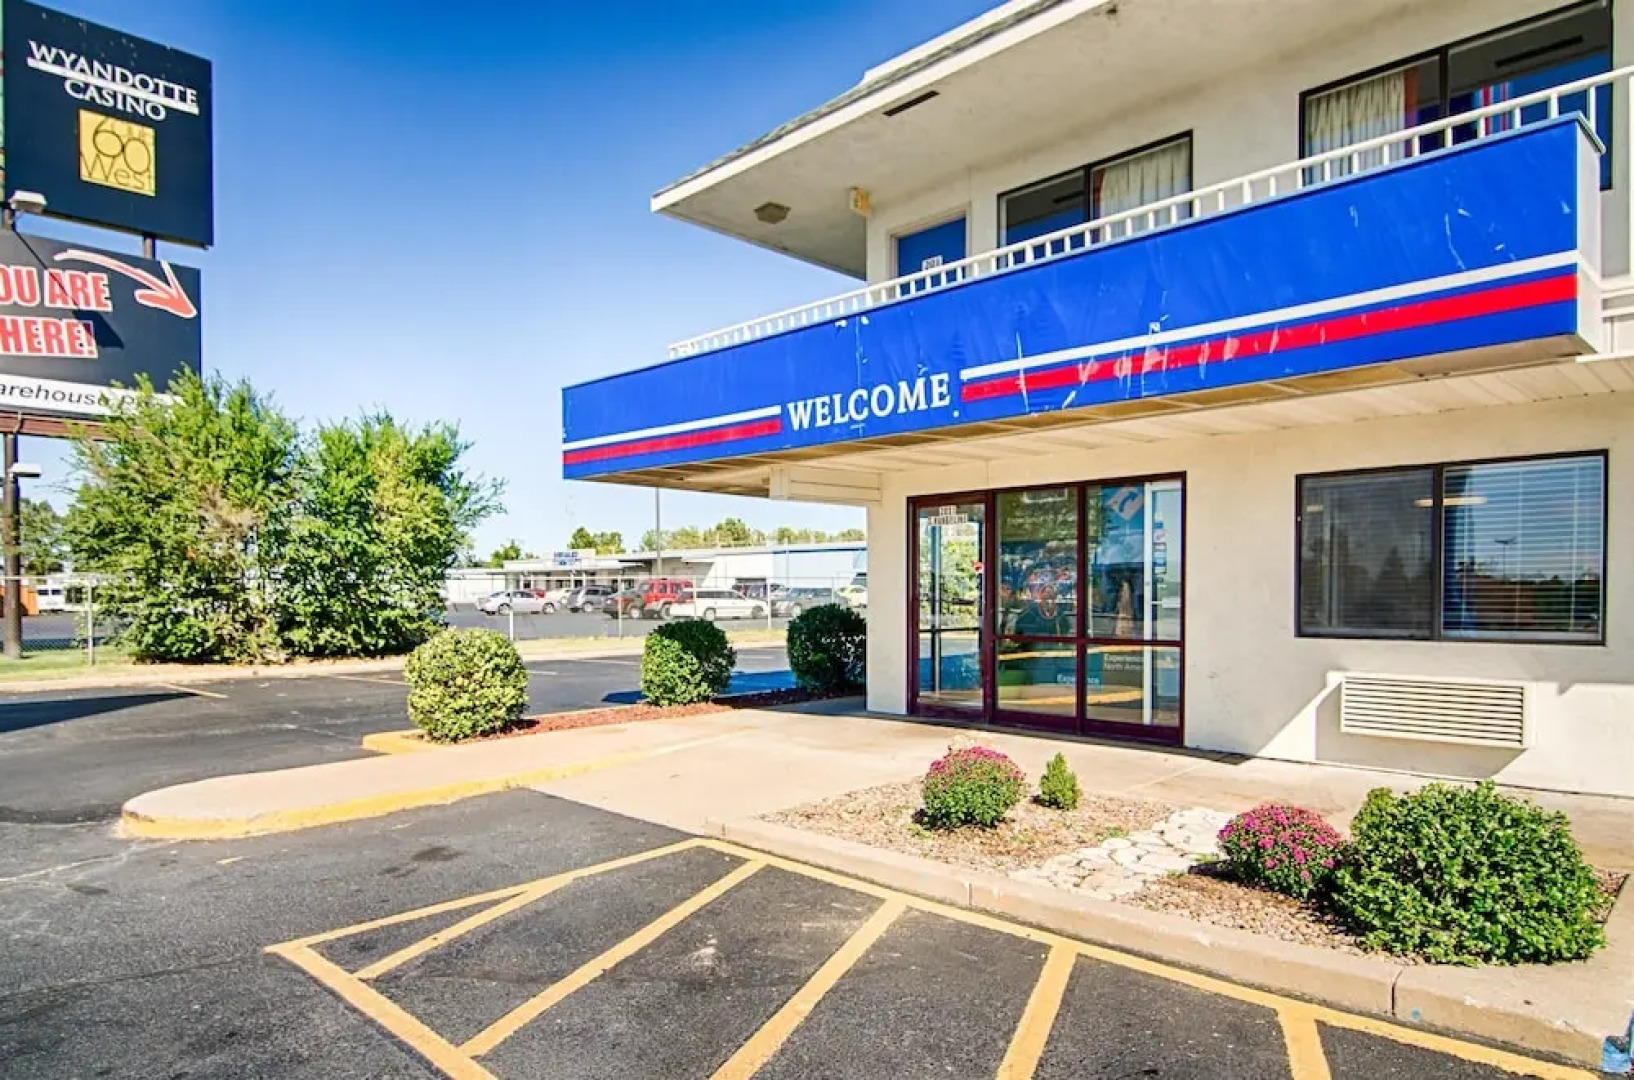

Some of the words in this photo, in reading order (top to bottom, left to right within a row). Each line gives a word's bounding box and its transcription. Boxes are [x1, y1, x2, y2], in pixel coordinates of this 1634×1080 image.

[27, 39, 197, 105] WYANDOTTE
[64, 78, 166, 121] CASINO
[93, 117, 151, 175] 60
[80, 149, 153, 191] West
[44, 268, 113, 312] ARE
[0, 315, 98, 359] HERE!
[787, 372, 950, 431] WELCOME
